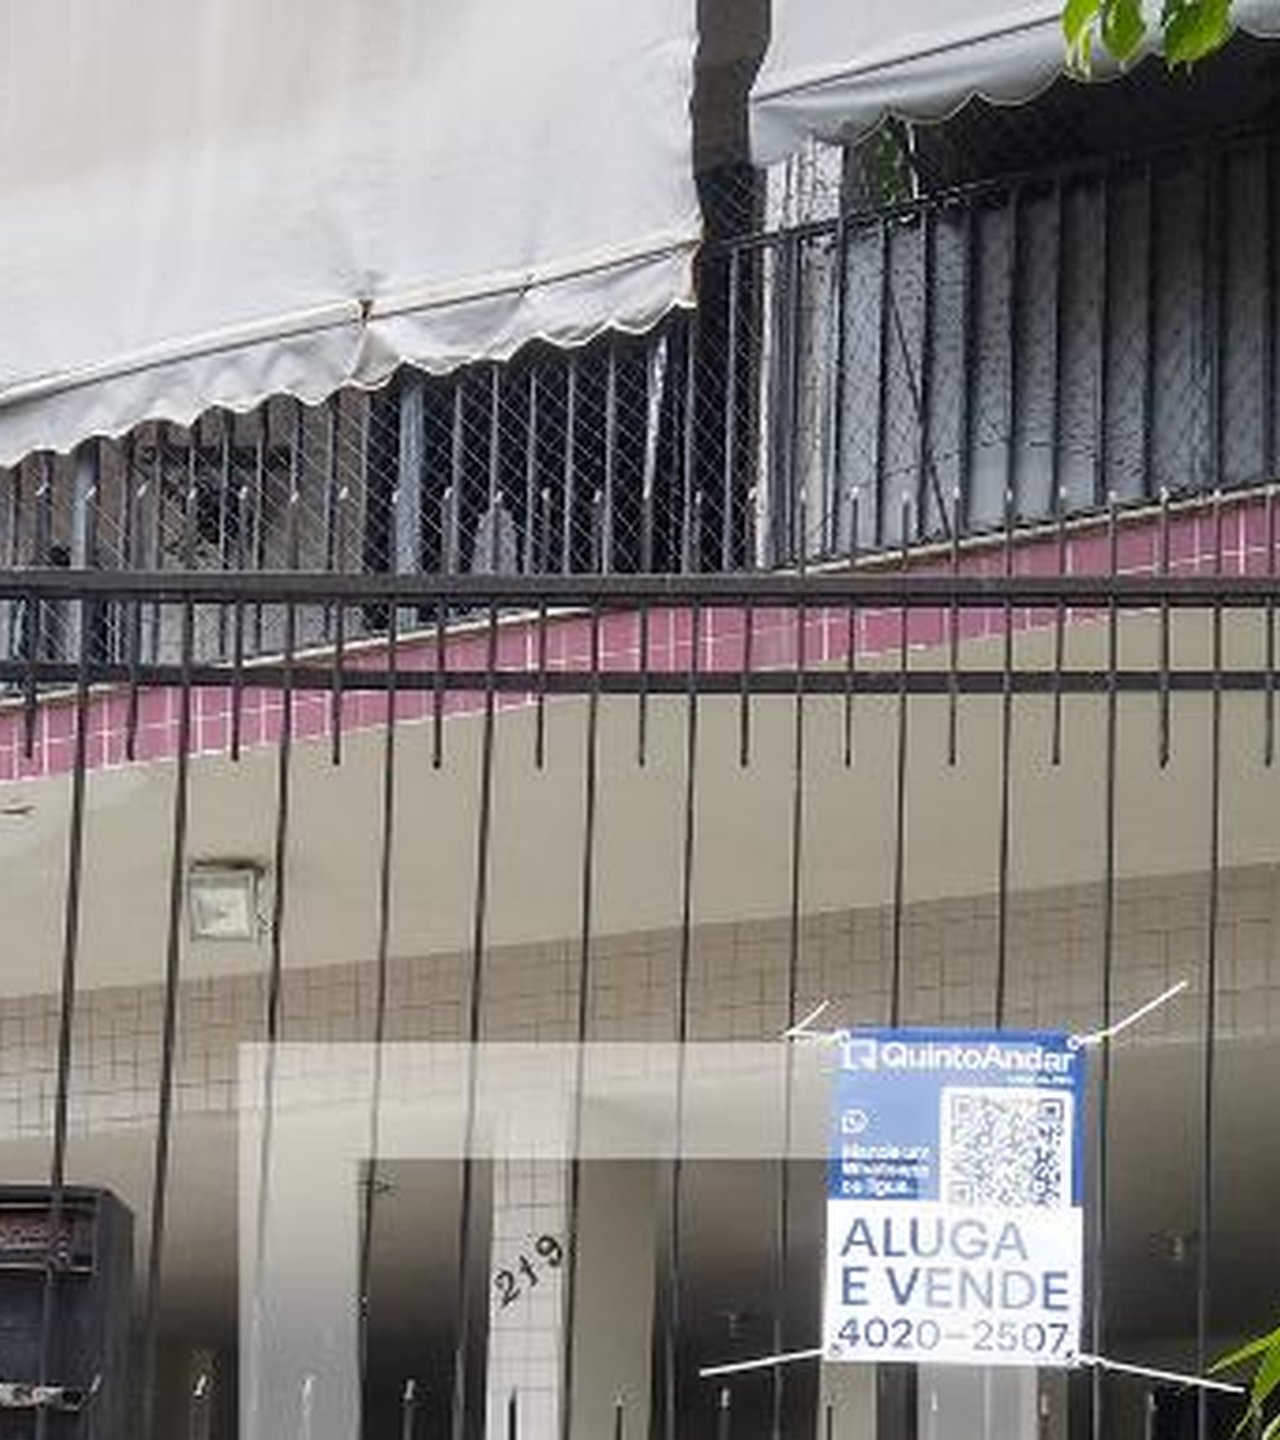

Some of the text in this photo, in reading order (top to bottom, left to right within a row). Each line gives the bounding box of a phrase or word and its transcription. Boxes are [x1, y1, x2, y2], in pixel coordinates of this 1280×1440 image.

[881, 1044, 1077, 1072] QuintoAndar
[840, 1218, 1029, 1261] ALUGA
[495, 1235, 563, 1308] 219
[842, 1266, 1069, 1311] E VENDE
[838, 1317, 1069, 1353] 4020-2507
